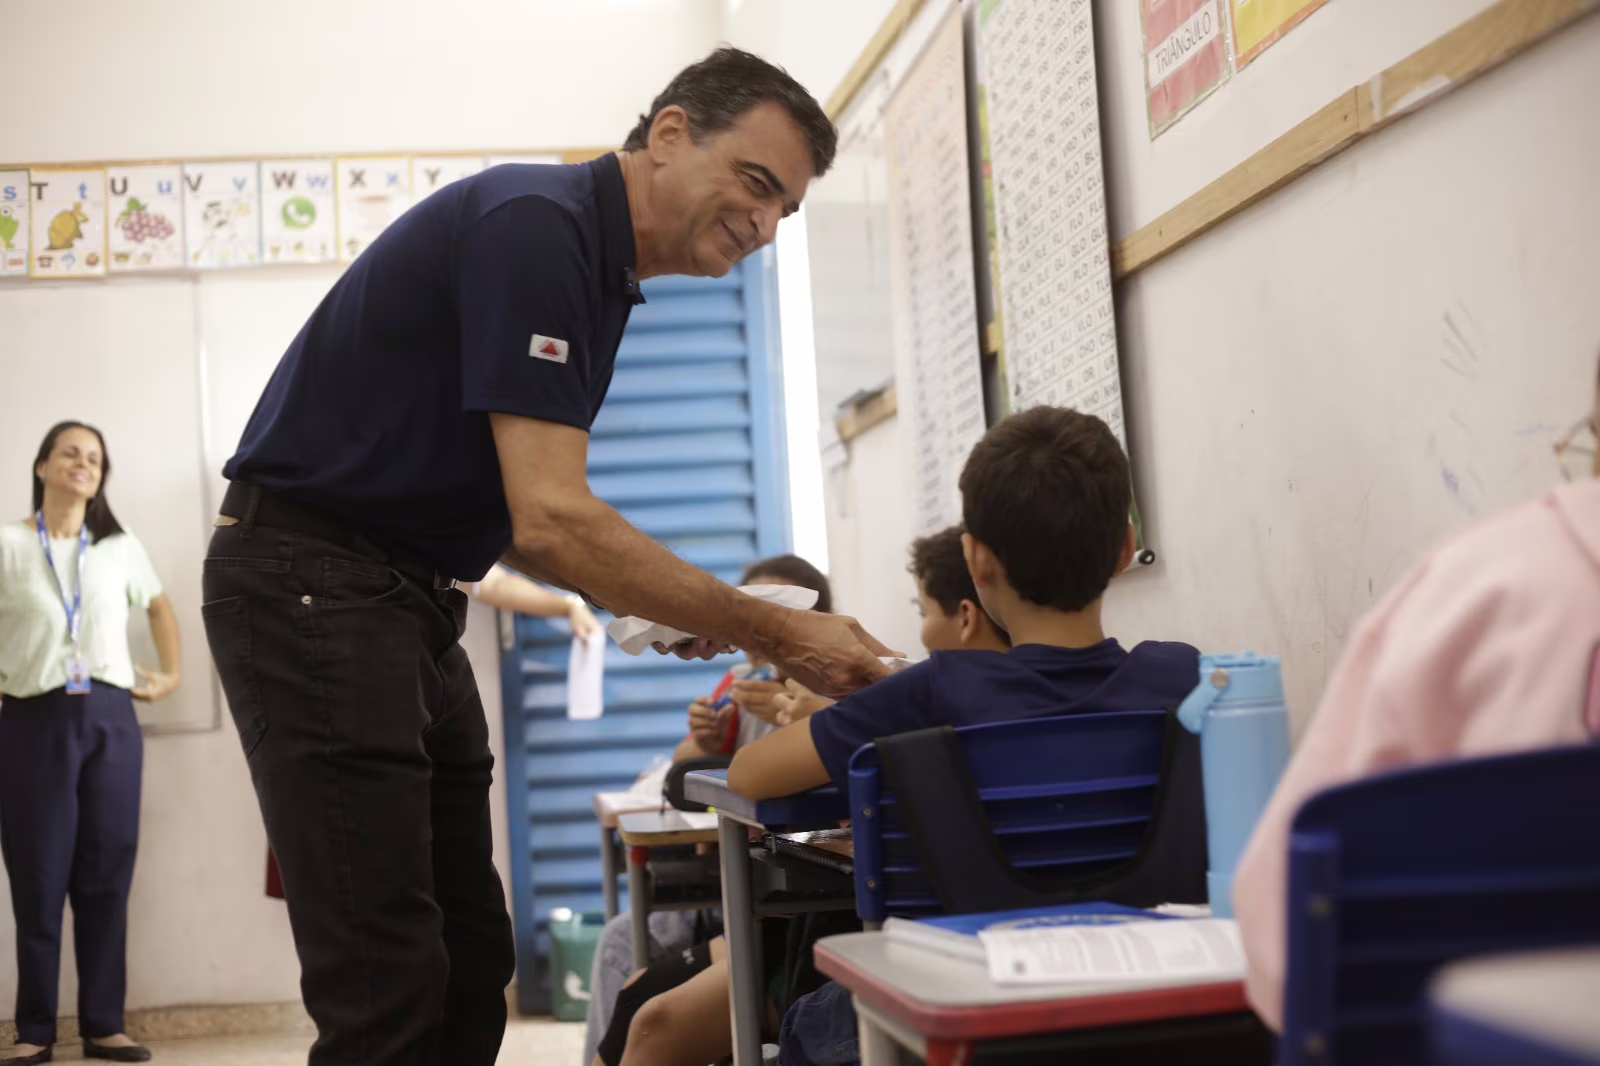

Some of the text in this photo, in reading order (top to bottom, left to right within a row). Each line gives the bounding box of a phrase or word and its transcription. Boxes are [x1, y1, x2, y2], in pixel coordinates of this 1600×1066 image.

[1155, 11, 1211, 75] TRIÂNGULO
[110, 176, 172, 195] U u
[185, 174, 202, 192] V
[272, 170, 296, 190] W
[349, 168, 367, 188] X
[424, 167, 441, 187] Y
[31, 182, 88, 200] T t
